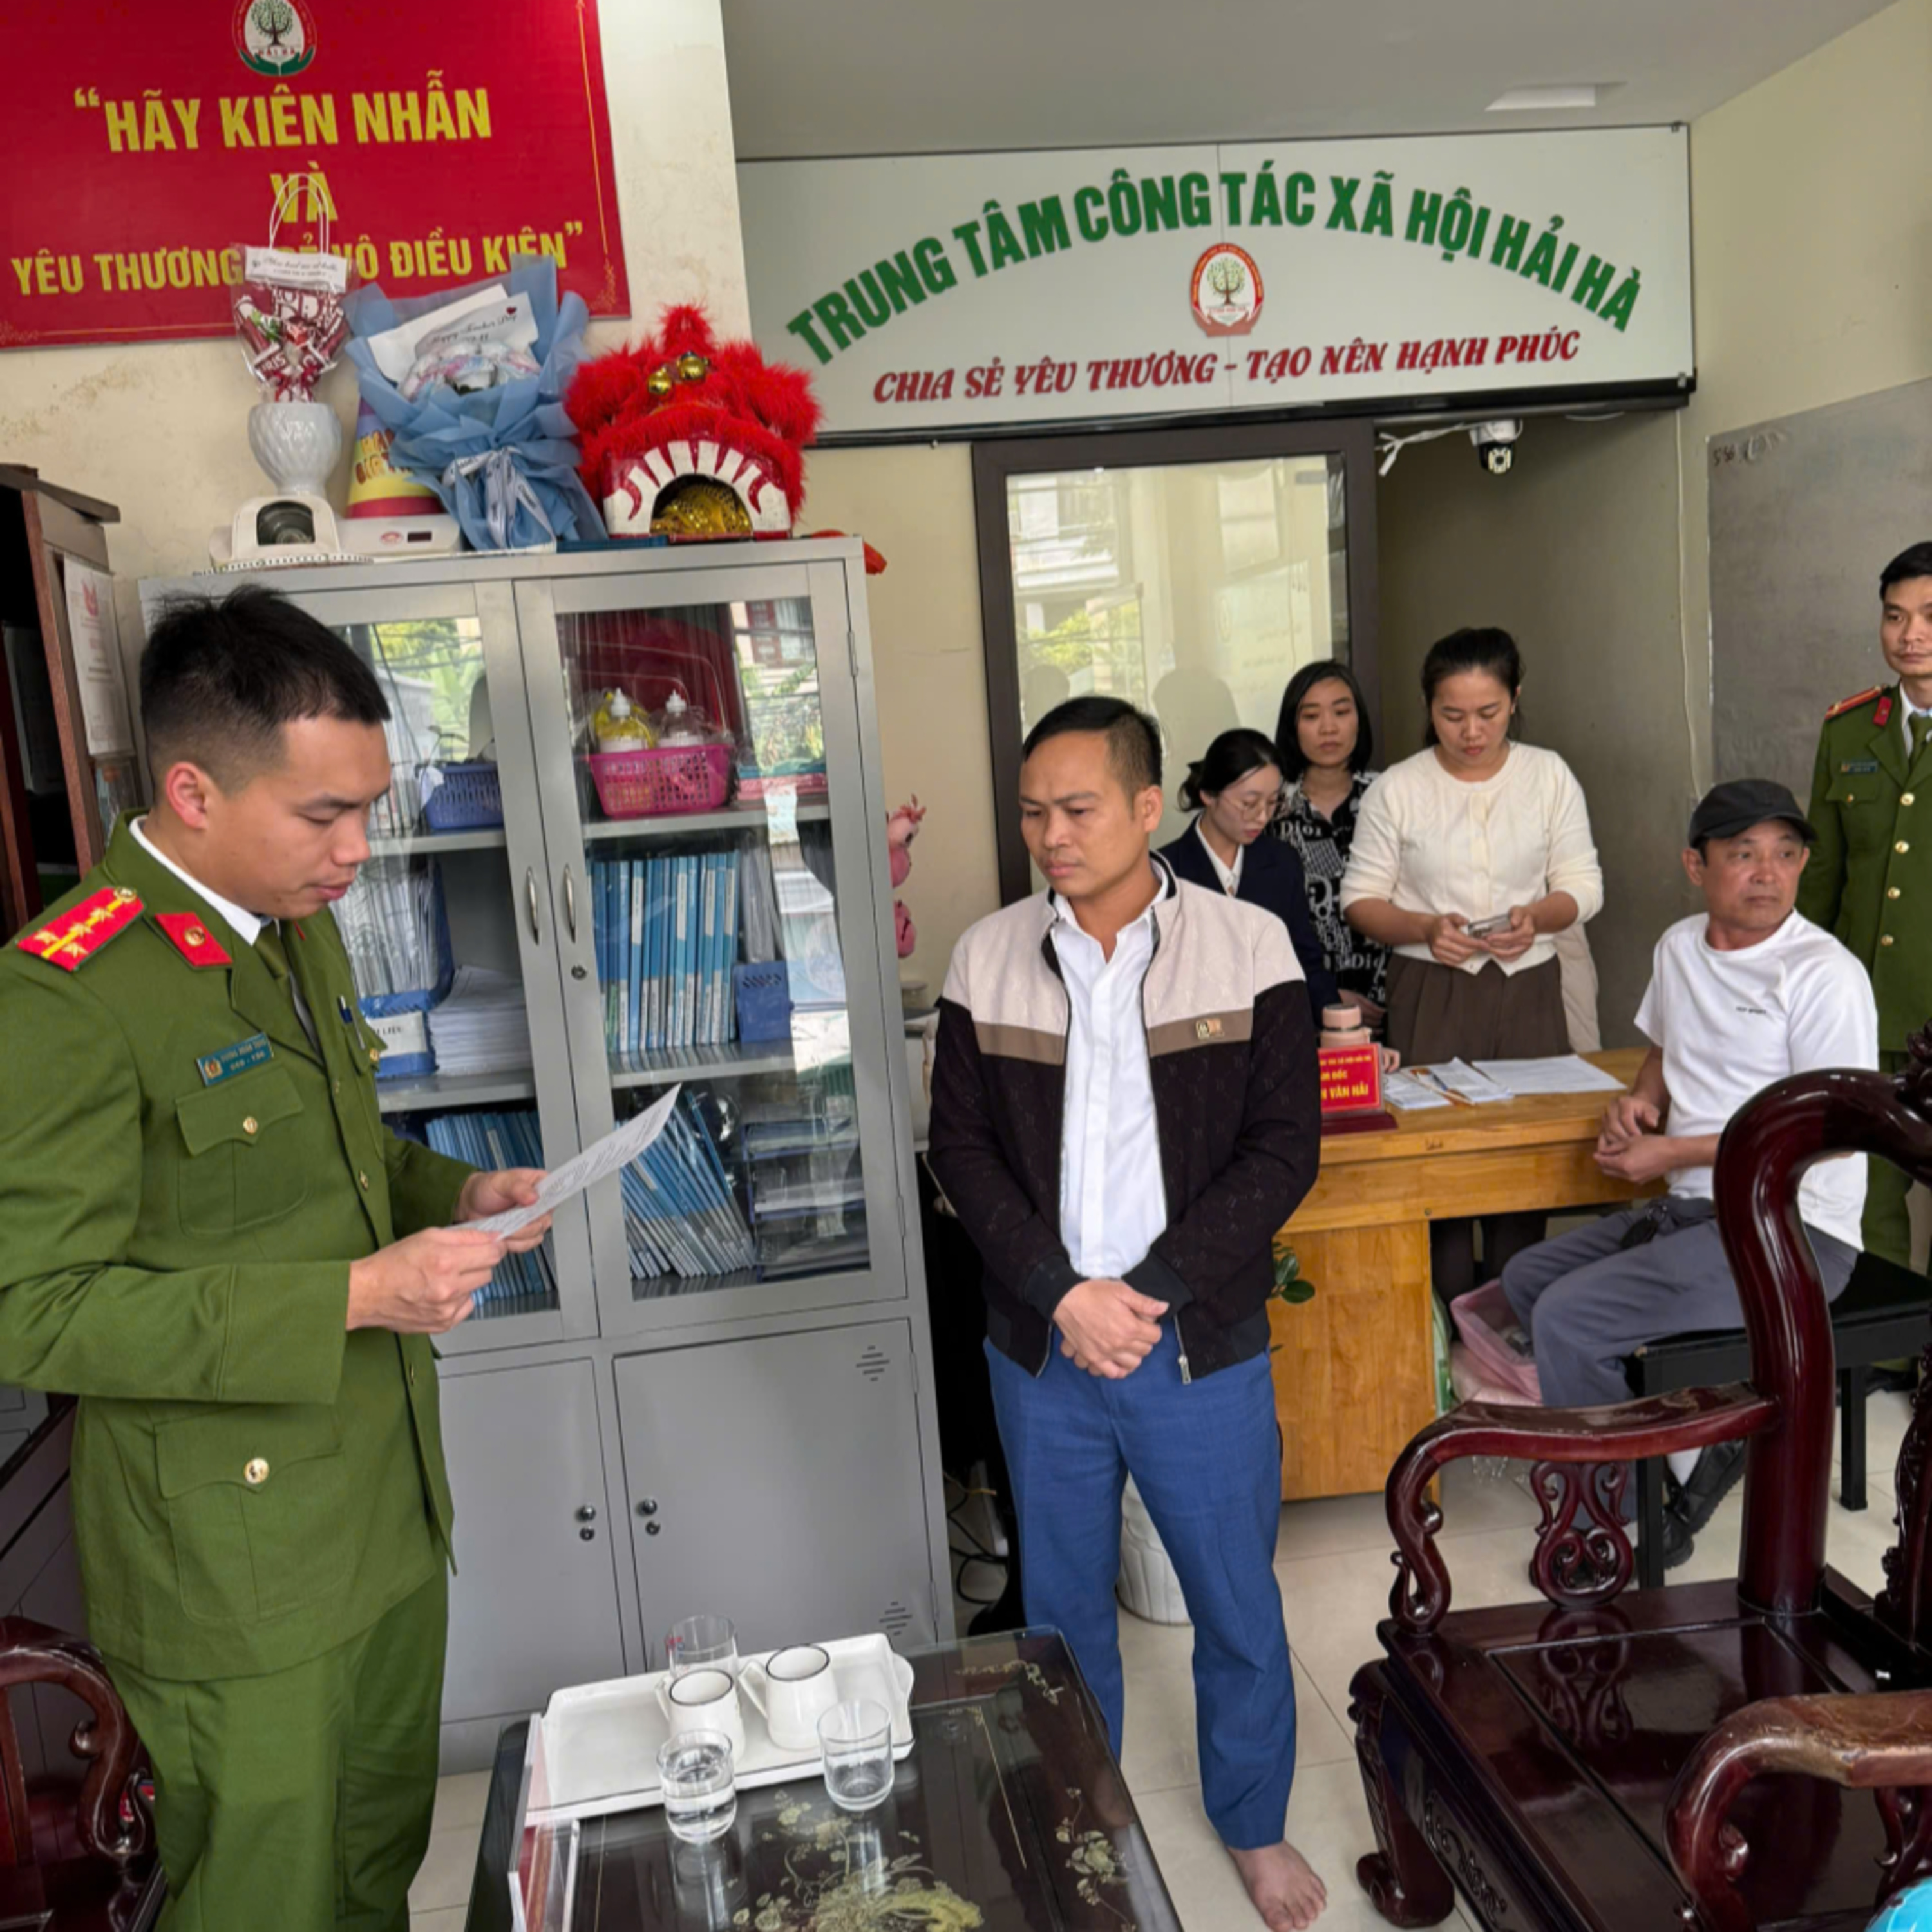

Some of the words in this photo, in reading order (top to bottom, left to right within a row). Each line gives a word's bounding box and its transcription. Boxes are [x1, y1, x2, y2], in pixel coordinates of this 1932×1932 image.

[74, 87, 200, 152] “HÃY
[219, 84, 338, 147] KIÊN
[352, 70, 491, 143] NHẪN
[270, 161, 338, 223] VÀ
[10, 249, 84, 296] YÊU
[93, 246, 244, 291] THƯƠNG
[389, 227, 472, 278] ĐIỀU
[786, 236, 958, 365] TRUNG
[952, 198, 1072, 278] TÂM
[1073, 168, 1211, 242] CÔNG
[1220, 160, 1316, 226] TÁC
[1325, 170, 1394, 237] XÃ
[1405, 187, 1491, 263] HỘI
[1490, 214, 1580, 294] HẢI
[1570, 254, 1641, 333] HÀ
[873, 368, 955, 404] CHIA
[964, 357, 1005, 399] SẺ
[1014, 355, 1077, 395] YÊU
[1087, 350, 1218, 392] THƯƠNG
[1247, 346, 1312, 384] TẠO
[1320, 337, 1388, 374] NÊN
[1396, 337, 1489, 374] HẠNH
[1494, 326, 1581, 365] PHÚC
